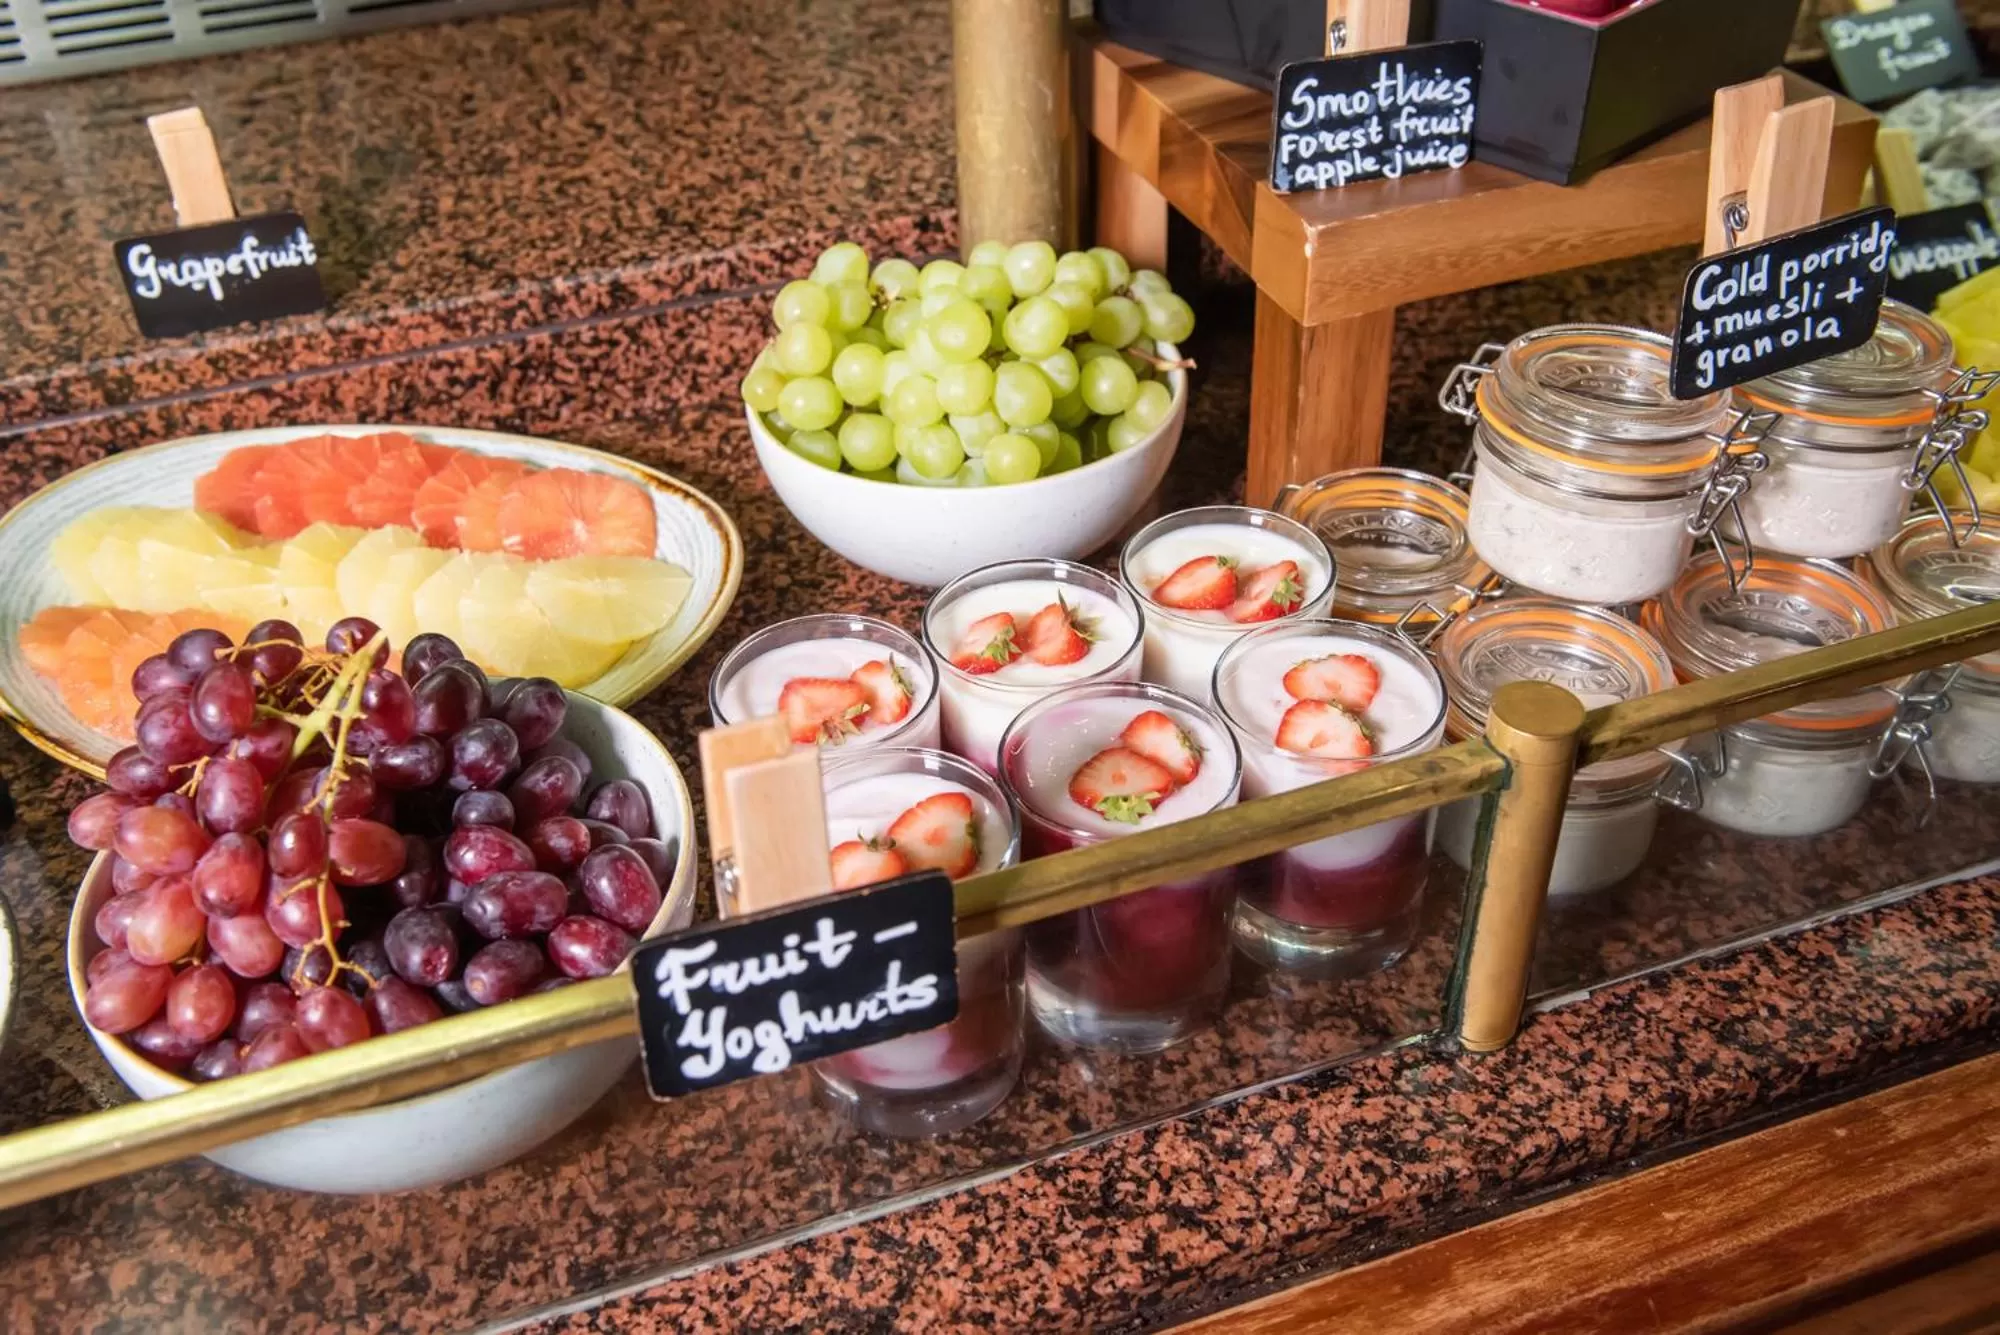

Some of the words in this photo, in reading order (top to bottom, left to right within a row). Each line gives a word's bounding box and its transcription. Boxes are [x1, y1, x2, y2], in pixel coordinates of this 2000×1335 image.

[1394, 104, 1475, 143] fruit
[1294, 151, 1380, 189] apple
[1382, 139, 1469, 179] juice
[127, 226, 318, 301] Grapefruit
[1692, 254, 1770, 311] Cold
[1695, 316, 1841, 389] granola
[655, 917, 857, 1016] Fruit
[676, 960, 939, 1079] Yoghurts
